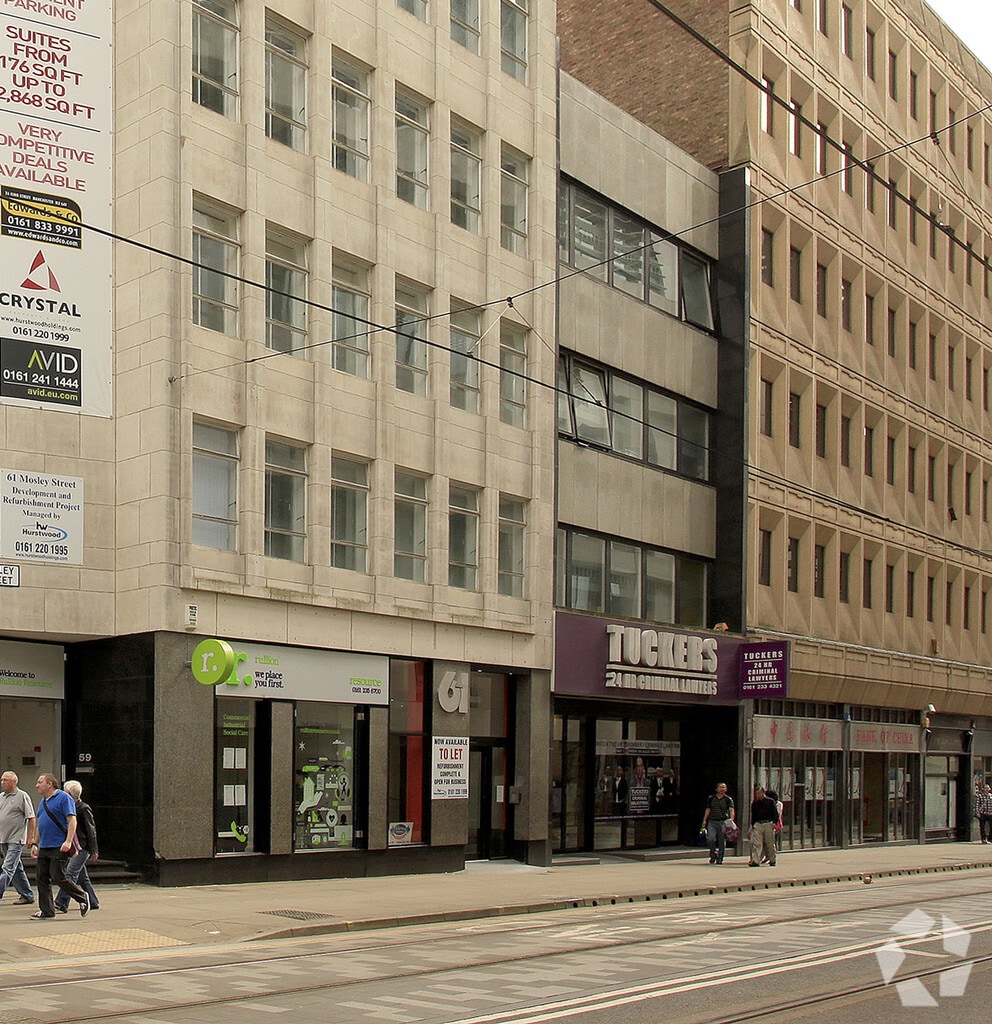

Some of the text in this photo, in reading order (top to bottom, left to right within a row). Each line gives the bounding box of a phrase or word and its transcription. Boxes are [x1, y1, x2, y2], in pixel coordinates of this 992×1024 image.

[6, 25, 72, 52] SUITES
[13, 42, 68, 67] FROM
[0, 55, 83, 86] 176 SQ FT
[12, 73, 66, 97] UP TO
[45, 97, 70, 115] SQ
[72, 103, 95, 119] FT
[17, 122, 63, 142] VERY
[13, 151, 68, 173] DEALS
[8, 215, 79, 237] 0161 833 9991
[7, 229, 79, 247] www.edwardsandco.com
[13, 326, 70, 342] 0161 220 1999
[28, 349, 78, 374] AVID
[3, 369, 79, 389] 0161 241 1444
[28, 387, 78, 401] avid.eu.com
[6, 473, 76, 489] 61 Mosley Street
[12, 486, 72, 500] Development and
[3, 496, 81, 512] Refurbishment Project
[22, 509, 61, 521] Managed by
[22, 528, 61, 539] Hurstwood
[15, 541, 68, 556] 0161 220 1995
[606, 624, 718, 673] TUCKERS
[744, 651, 783, 659] TUCKERS
[254, 655, 280, 666] rullion
[0, 677, 22, 686] Rullion
[29, 671, 36, 679] to
[255, 671, 283, 681] we place
[349, 677, 382, 687] resource
[254, 679, 284, 689] you first.
[606, 671, 718, 696] 24 HR CRIMINAL LAWYERS
[438, 671, 469, 714] 61
[857, 730, 914, 745] BANK OF CHINA
[78, 753, 92, 762] 59
[439, 748, 463, 760] TO LET
